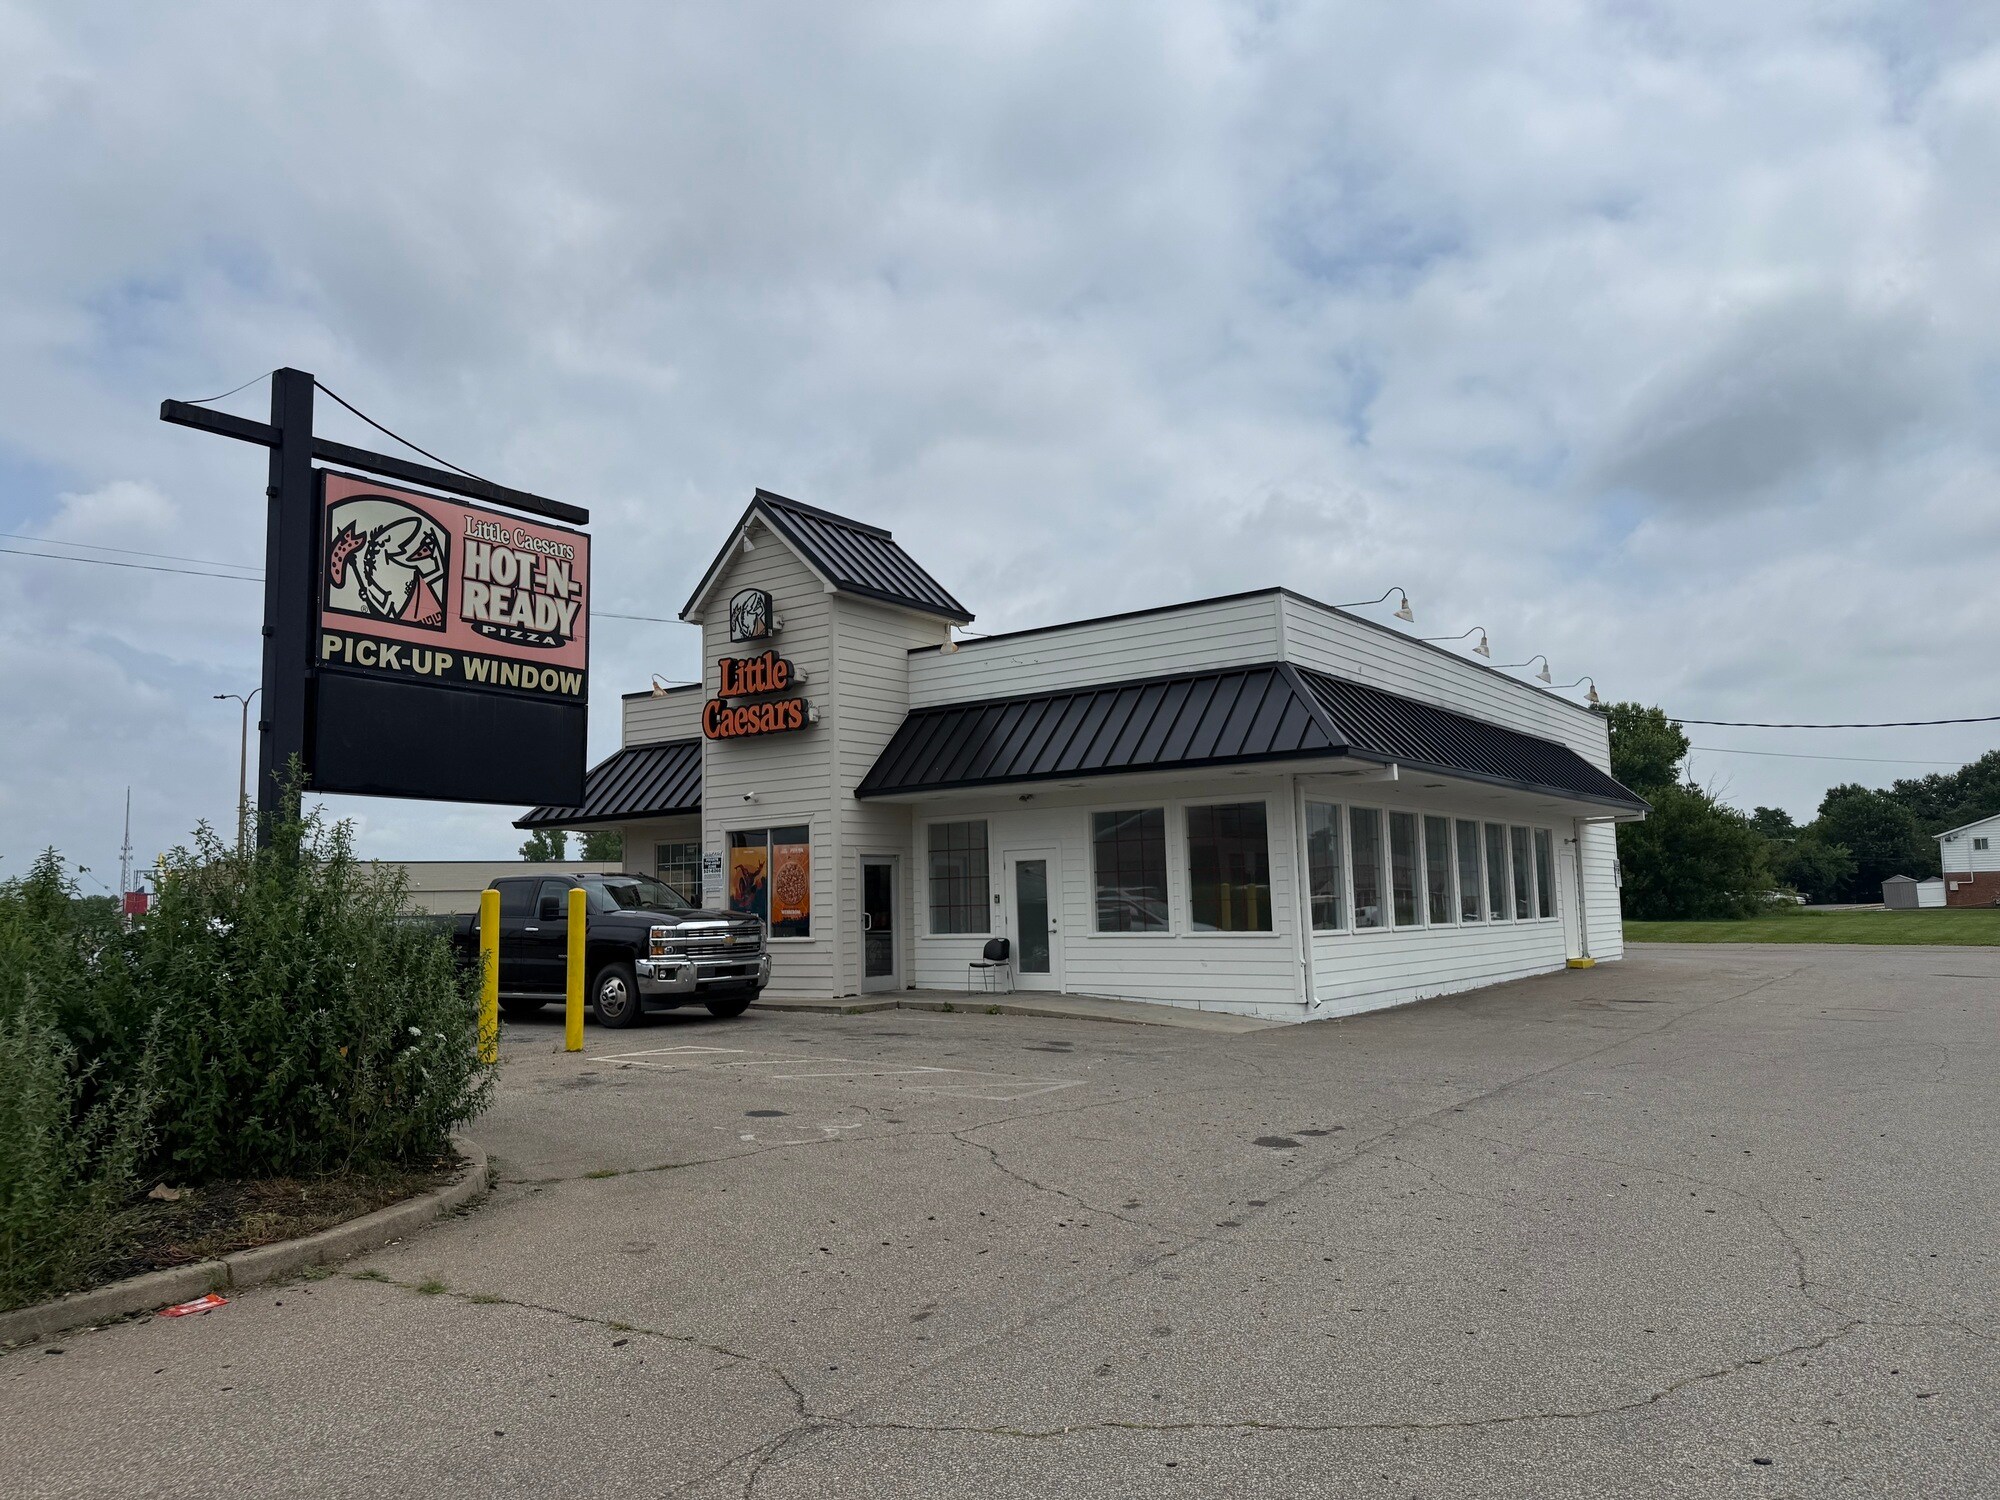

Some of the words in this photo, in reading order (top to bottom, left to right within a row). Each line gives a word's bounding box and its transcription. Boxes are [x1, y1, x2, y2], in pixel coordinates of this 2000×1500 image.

[464, 515, 510, 545] Little
[513, 527, 575, 560] Caesars
[462, 537, 582, 600] HOT-N-
[460, 579, 581, 640] READY
[481, 624, 557, 646] PIZZA
[321, 634, 454, 677] PICK-UP
[462, 656, 583, 696] WINDOW
[718, 650, 790, 698] Little
[702, 698, 805, 739] Caesars
